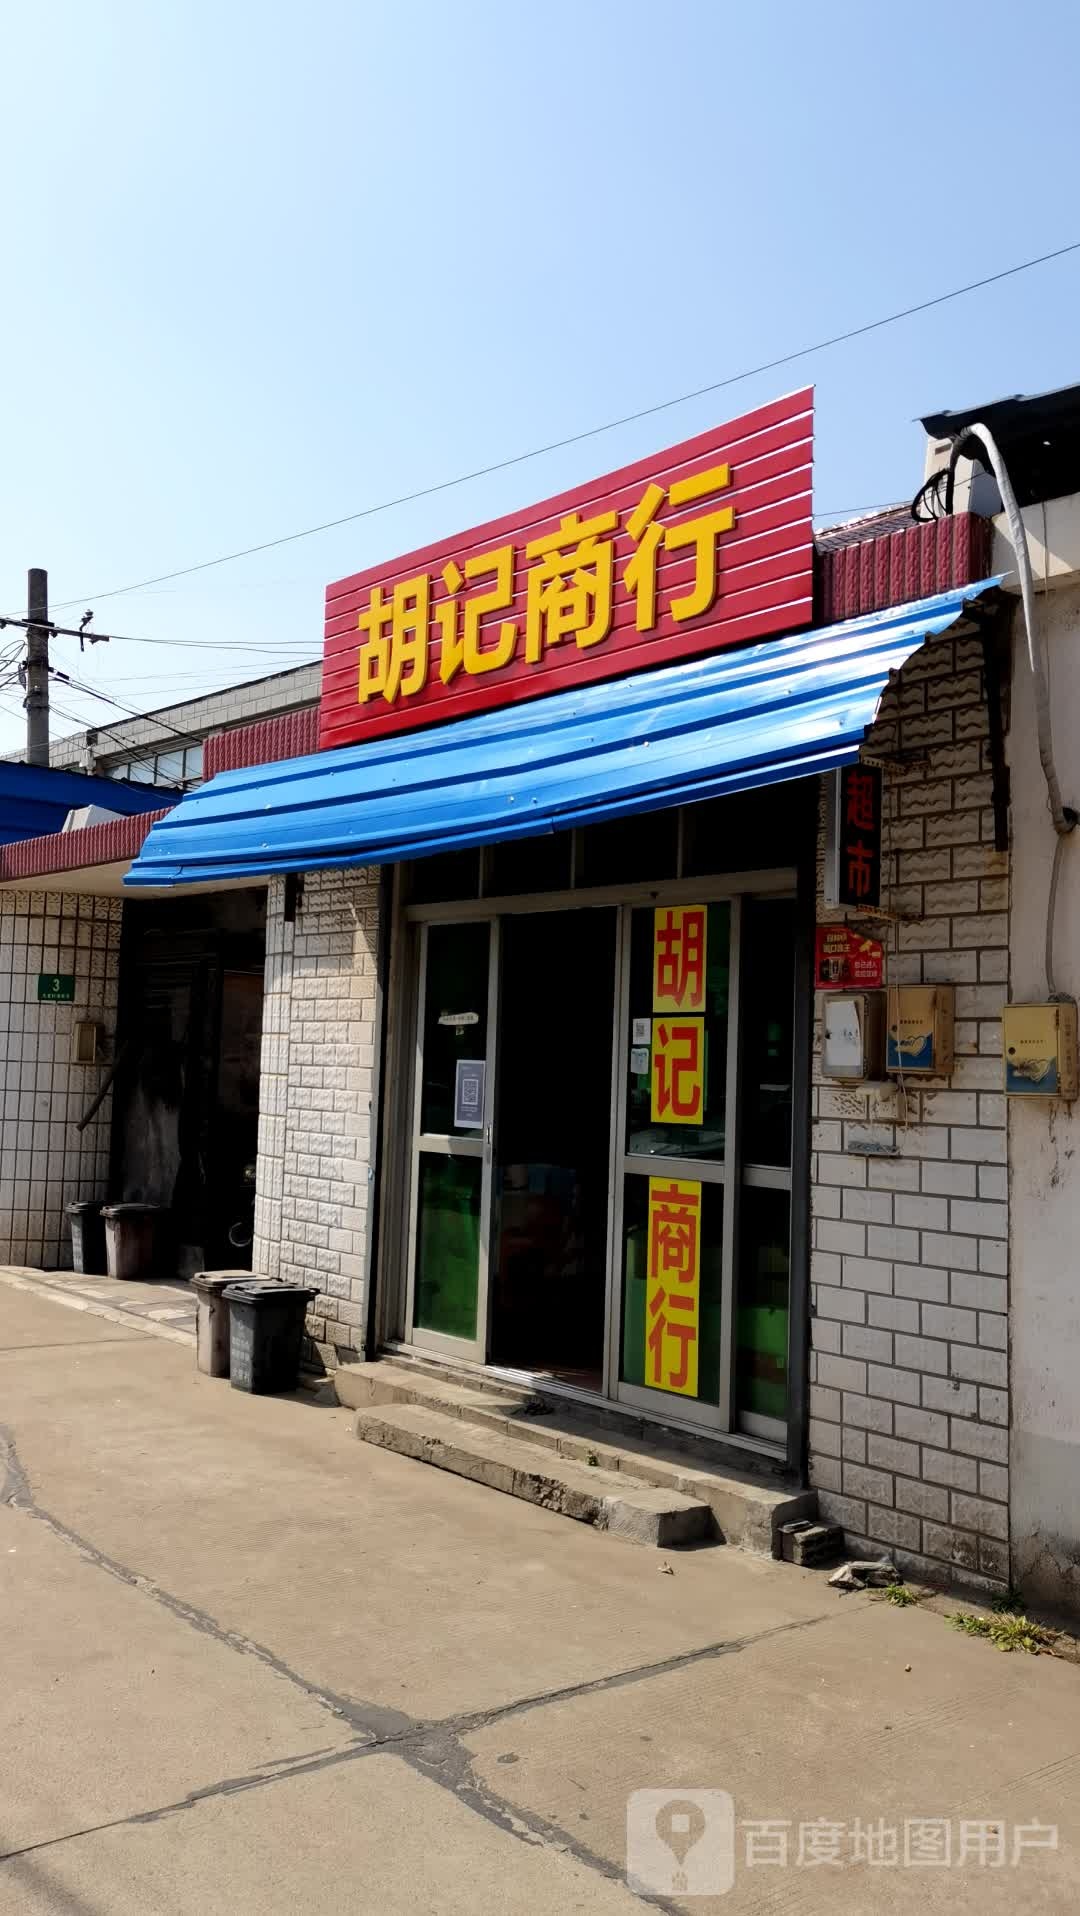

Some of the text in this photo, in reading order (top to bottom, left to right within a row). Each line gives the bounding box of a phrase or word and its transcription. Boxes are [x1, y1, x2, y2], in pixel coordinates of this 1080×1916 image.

[358, 463, 737, 704] 胡记商行
[847, 769, 875, 897] 超市
[53, 979, 60, 992] 3
